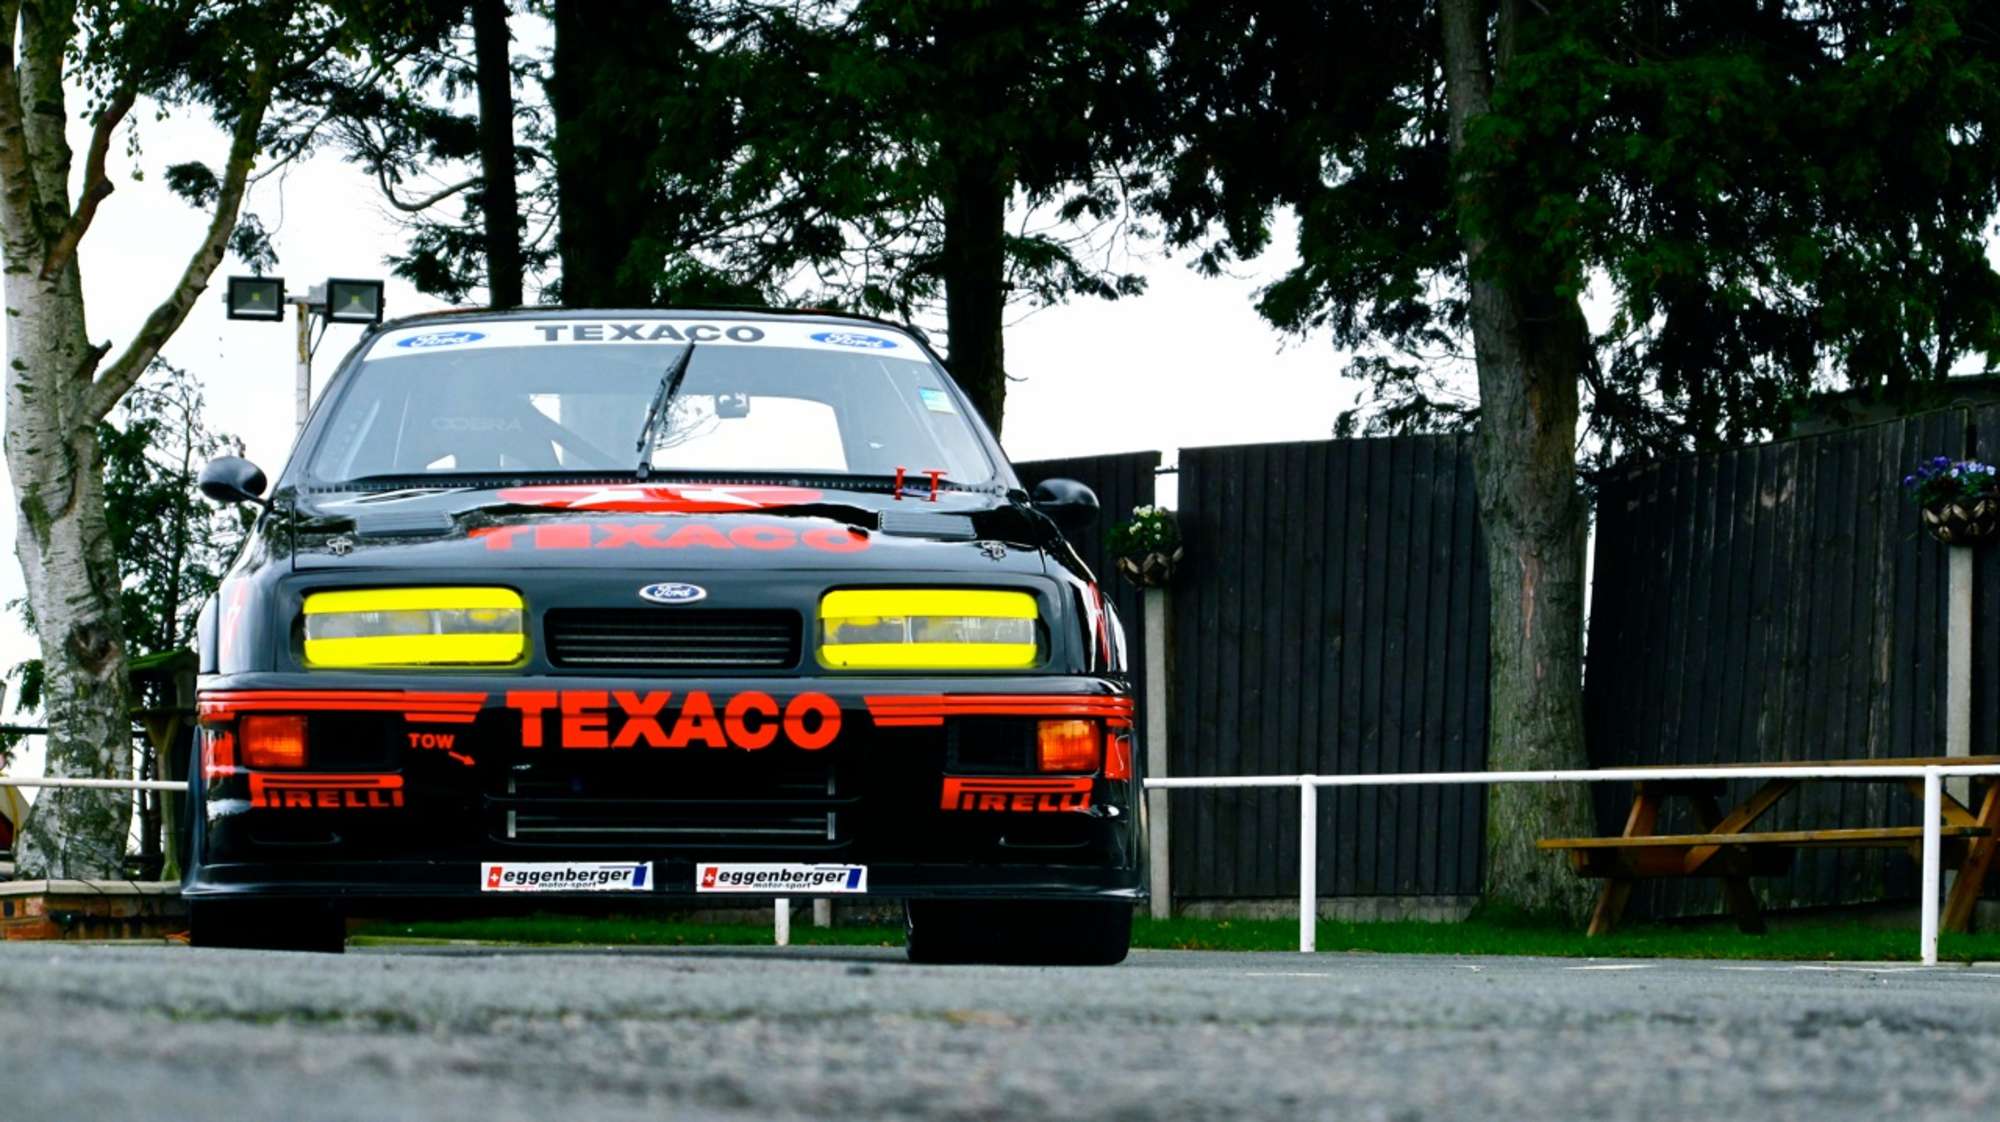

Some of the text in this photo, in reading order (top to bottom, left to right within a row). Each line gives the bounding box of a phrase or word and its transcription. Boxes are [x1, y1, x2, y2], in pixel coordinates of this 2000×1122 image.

[410, 333, 472, 347] Ford
[535, 324, 765, 343] TEXACO
[824, 332, 883, 347] Ford
[468, 522, 872, 553] TEXACO
[505, 690, 843, 750] TEXACO
[408, 732, 455, 749] TOW
[249, 774, 405, 808] PIRELLI
[940, 777, 1095, 812] PIRELLI
[504, 868, 632, 885] eggenberger
[719, 868, 846, 886] eggenberger
